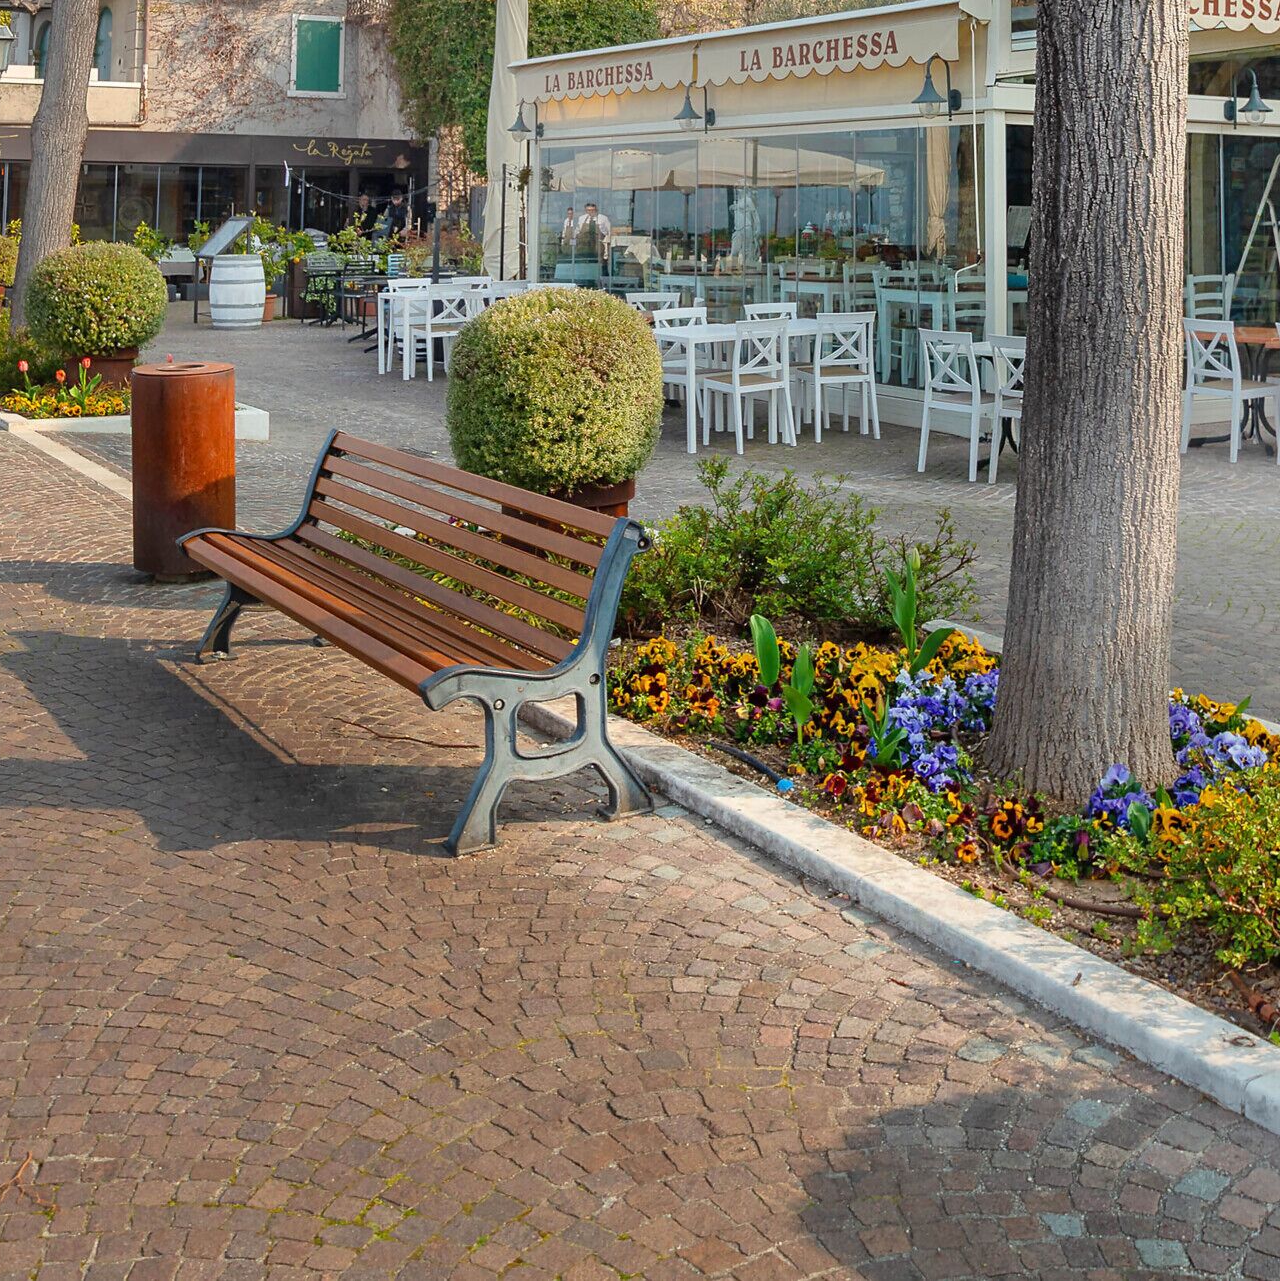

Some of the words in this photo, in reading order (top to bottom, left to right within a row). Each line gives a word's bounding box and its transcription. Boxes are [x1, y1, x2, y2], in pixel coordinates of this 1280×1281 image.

[740, 49, 762, 72] LA
[772, 30, 899, 69] BARCHESSA
[545, 74, 561, 93] LA
[567, 61, 654, 90] BARCHESSA
